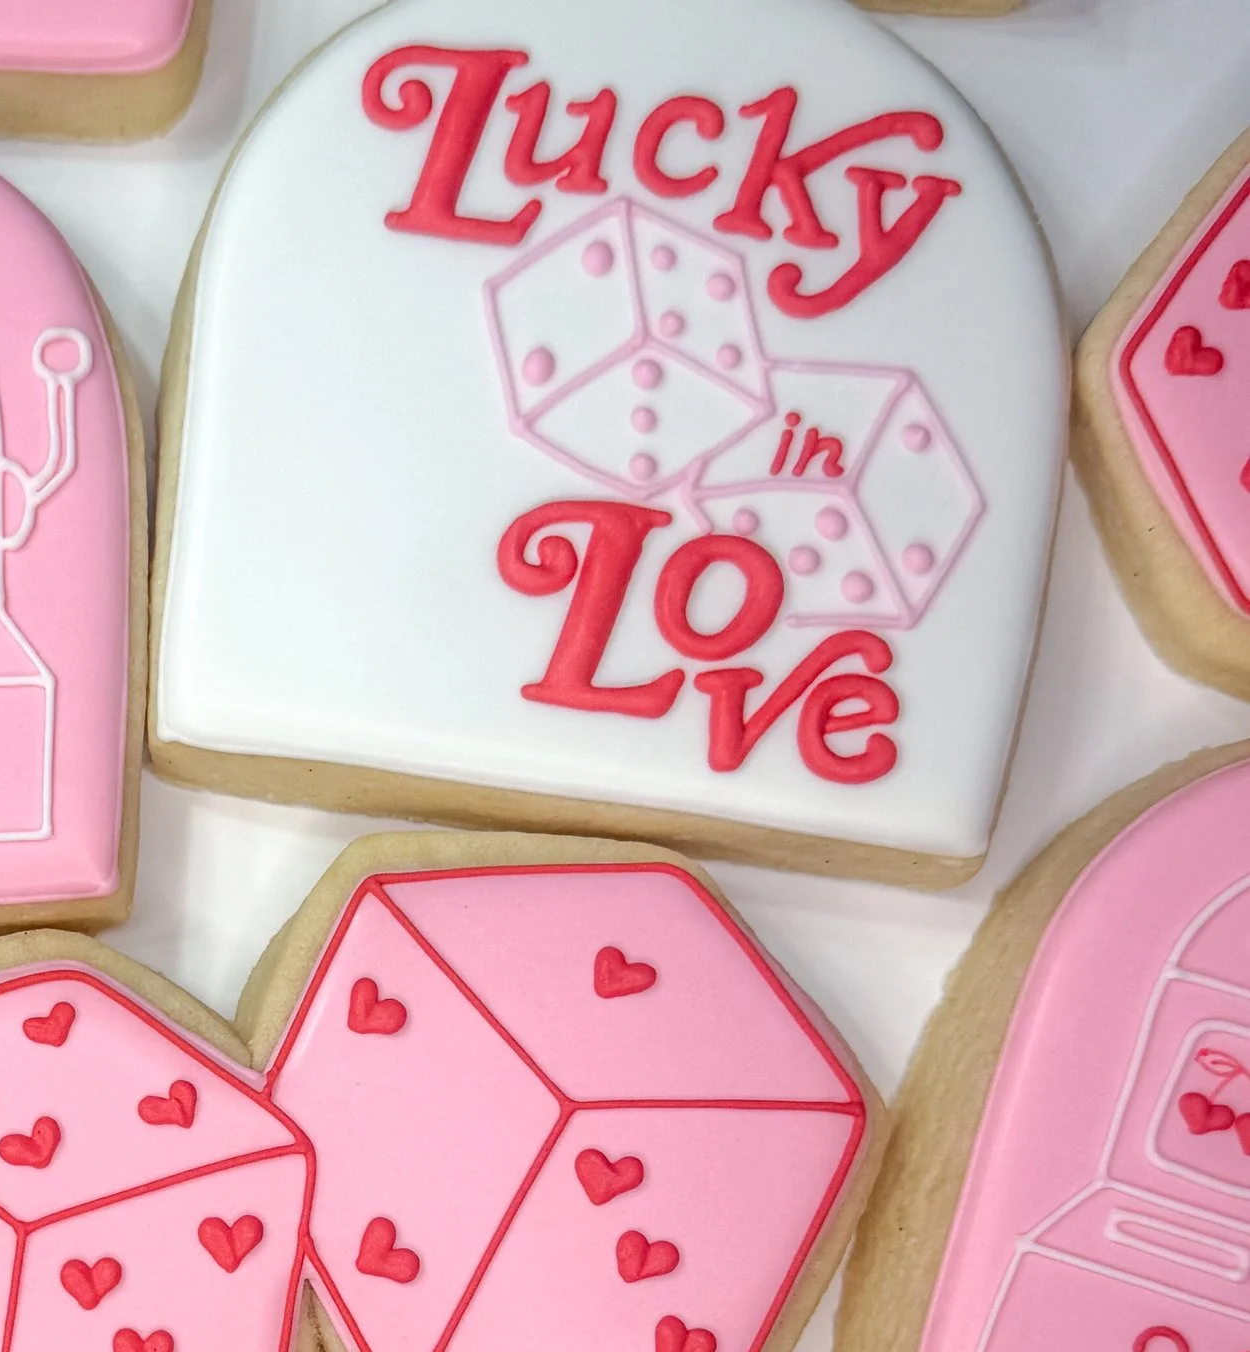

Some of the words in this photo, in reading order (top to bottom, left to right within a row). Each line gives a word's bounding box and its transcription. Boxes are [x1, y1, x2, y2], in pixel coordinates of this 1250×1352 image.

[362, 45, 961, 318] Lucky
[770, 413, 845, 478] in
[497, 500, 899, 784] Love
